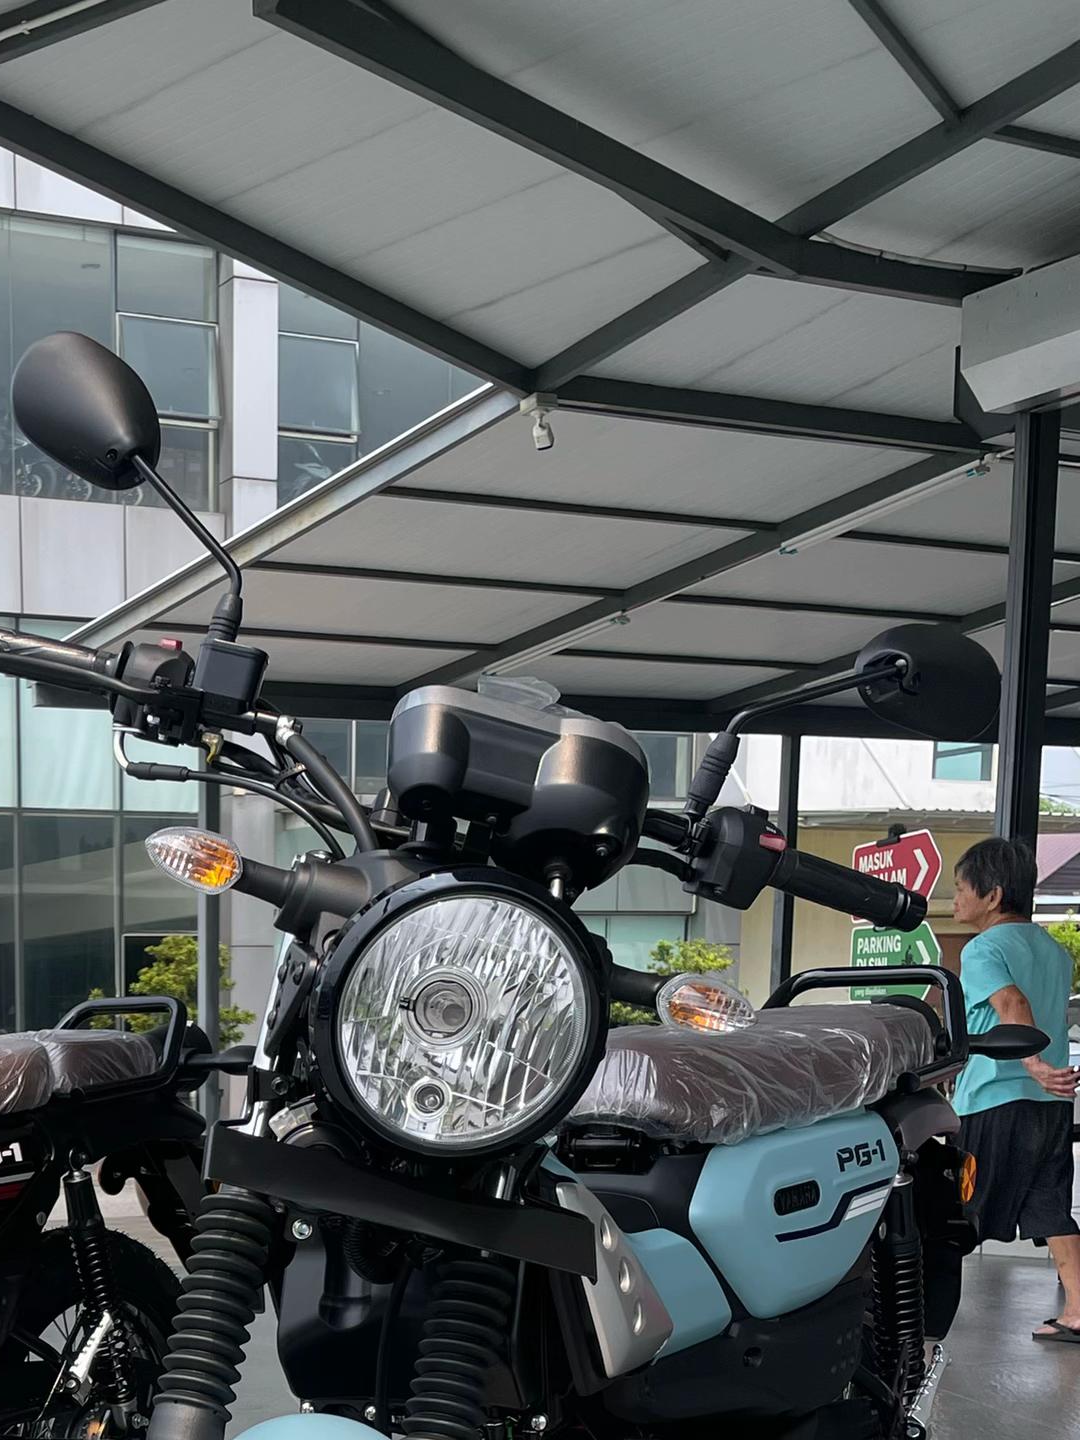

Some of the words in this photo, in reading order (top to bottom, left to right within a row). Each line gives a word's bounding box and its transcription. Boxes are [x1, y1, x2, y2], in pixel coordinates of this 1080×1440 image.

[858, 849, 894, 873] MASUK
[857, 934, 902, 954] PARKING
[835, 1138, 887, 1172] PG-1
